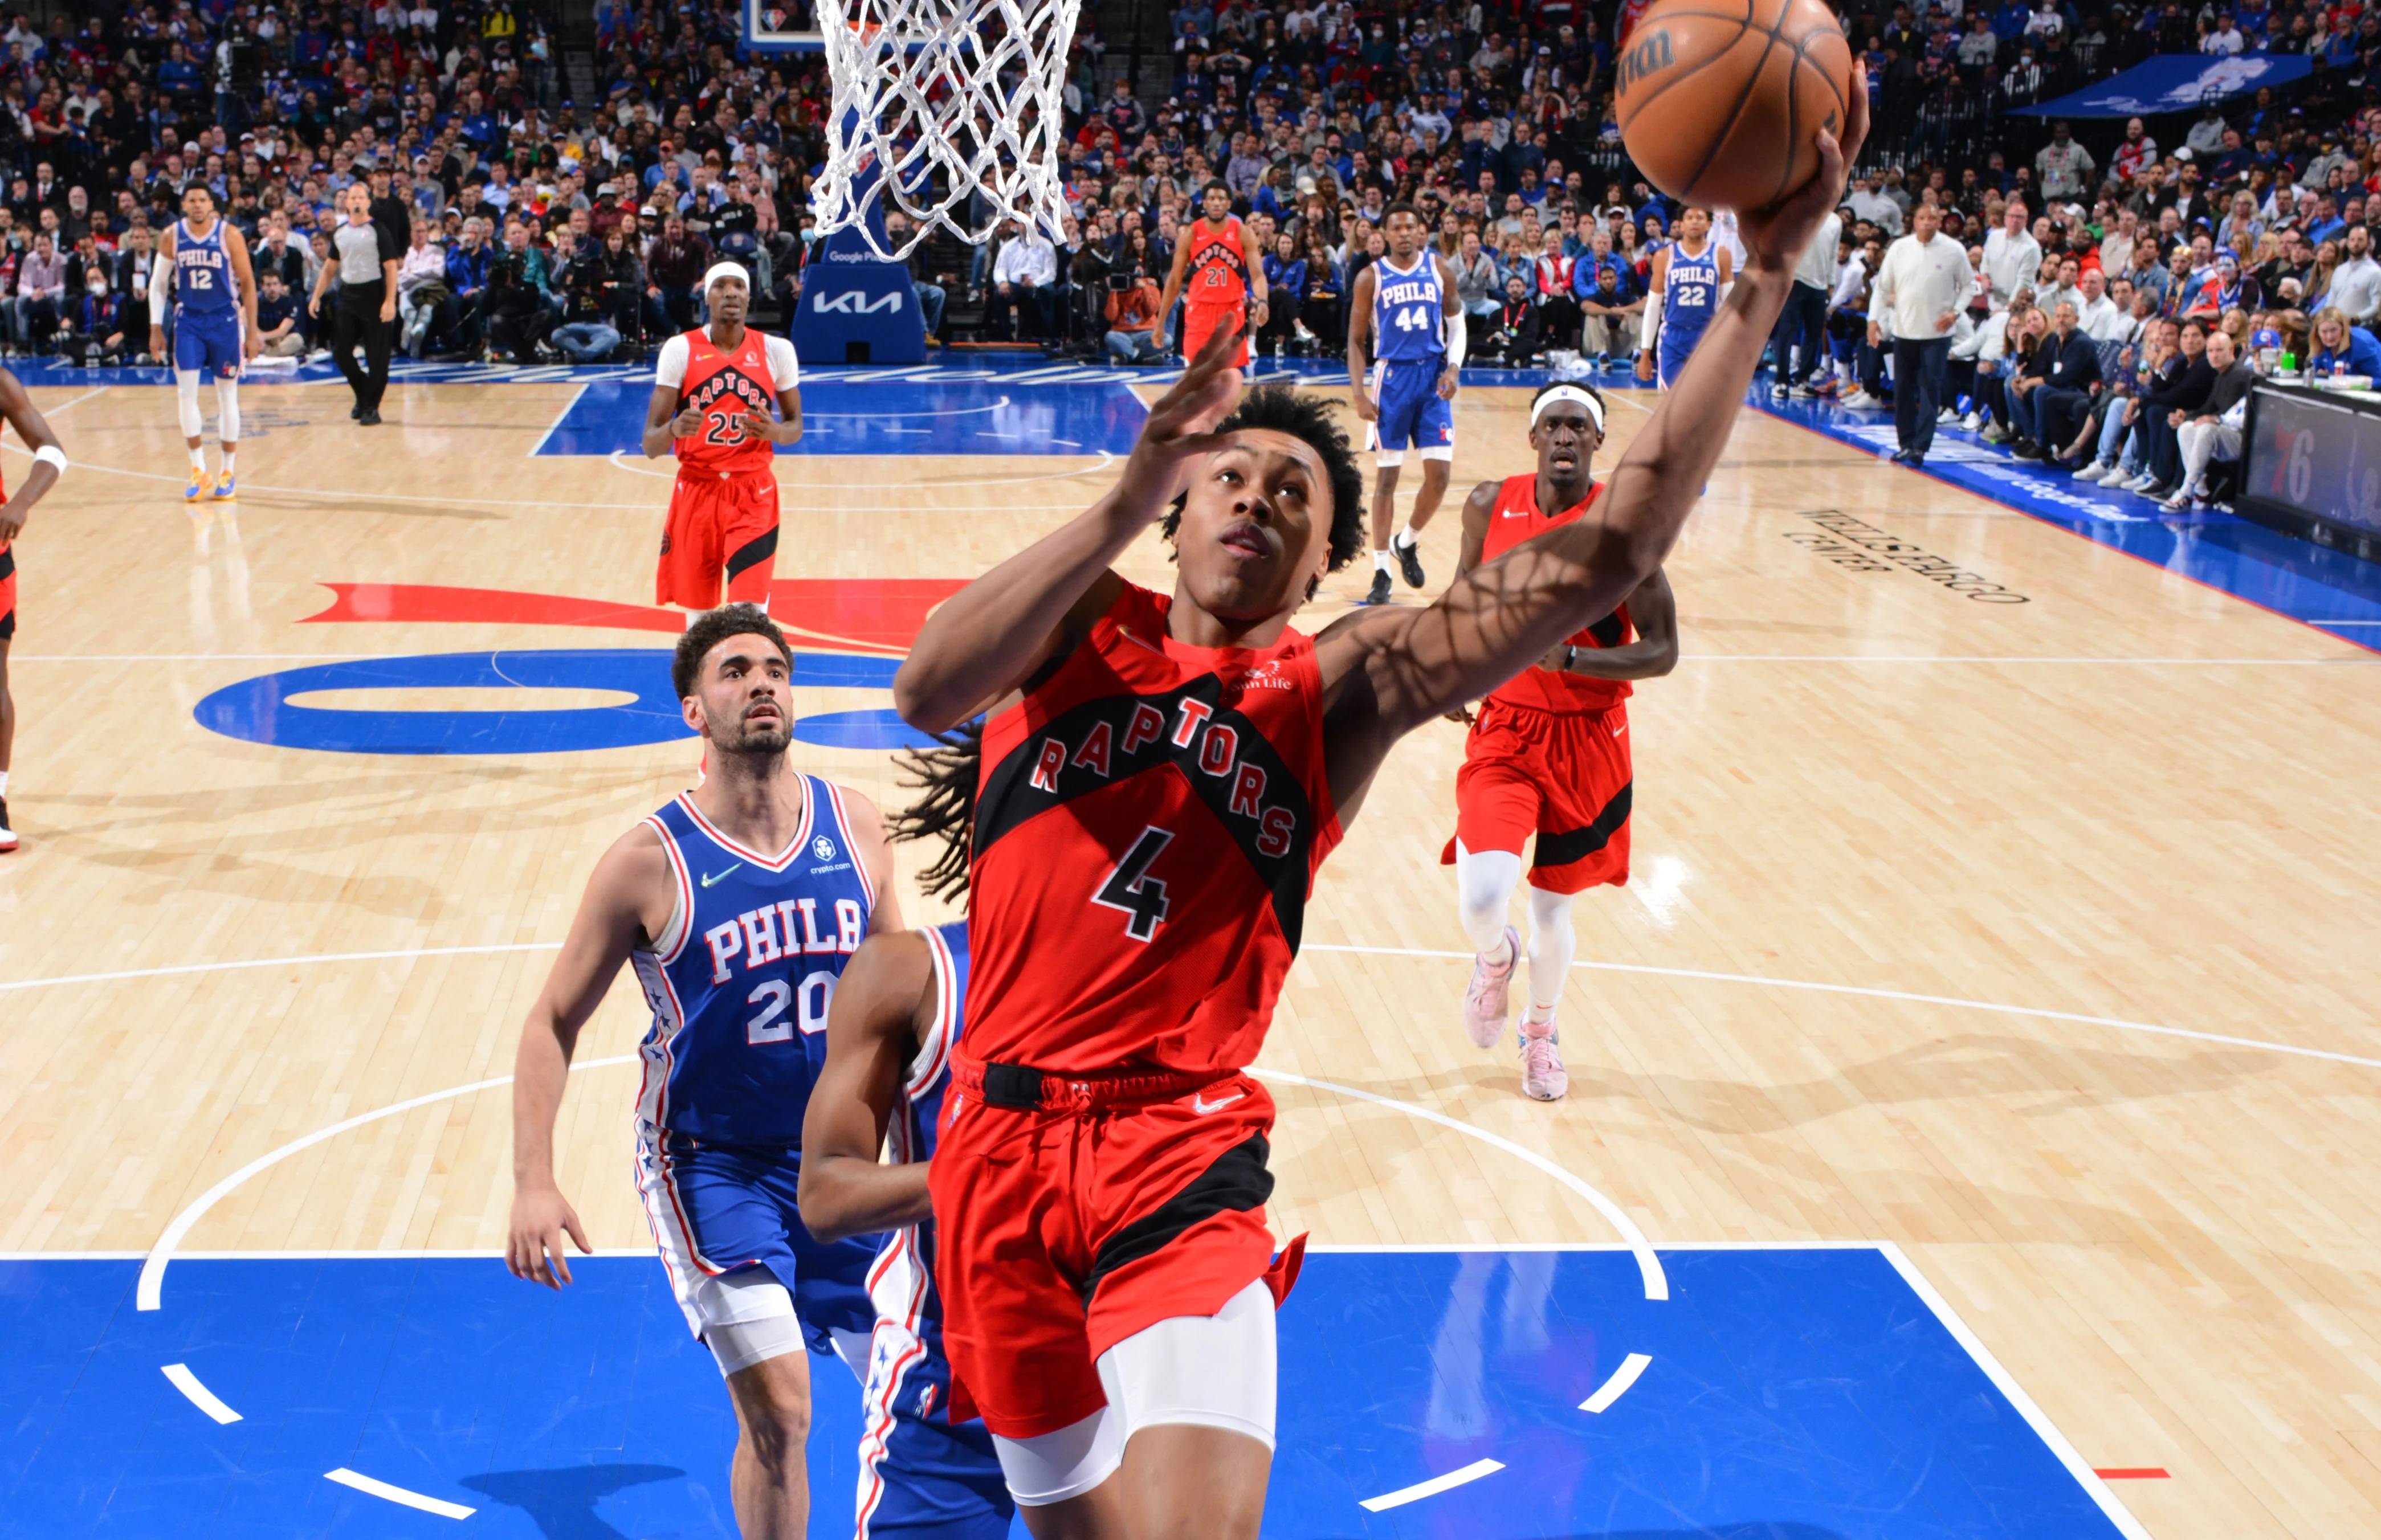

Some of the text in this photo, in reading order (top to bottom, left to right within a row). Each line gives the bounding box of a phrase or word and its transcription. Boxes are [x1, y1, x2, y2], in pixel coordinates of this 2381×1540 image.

[177, 249, 223, 268] PHILA
[829, 250, 863, 264] Google
[189, 269, 213, 289] 12
[1205, 267, 1227, 287] 21
[1670, 266, 1715, 286] PHILA
[813, 291, 902, 313] KIA
[1381, 282, 1437, 309] PHILA
[1677, 285, 1706, 307] 22
[1395, 306, 1428, 332] 44
[706, 411, 748, 446] 25
[2270, 423, 2315, 504] 76
[1782, 533, 1893, 571] CENTER
[1883, 554, 2031, 603] FARGO
[1263, 677, 1292, 691] Life
[1029, 696, 1296, 859] RAPTORS
[810, 862, 851, 875] crypto.com
[1091, 826, 1176, 943] 4
[703, 898, 861, 986] PHILA
[747, 970, 839, 1045] 20
